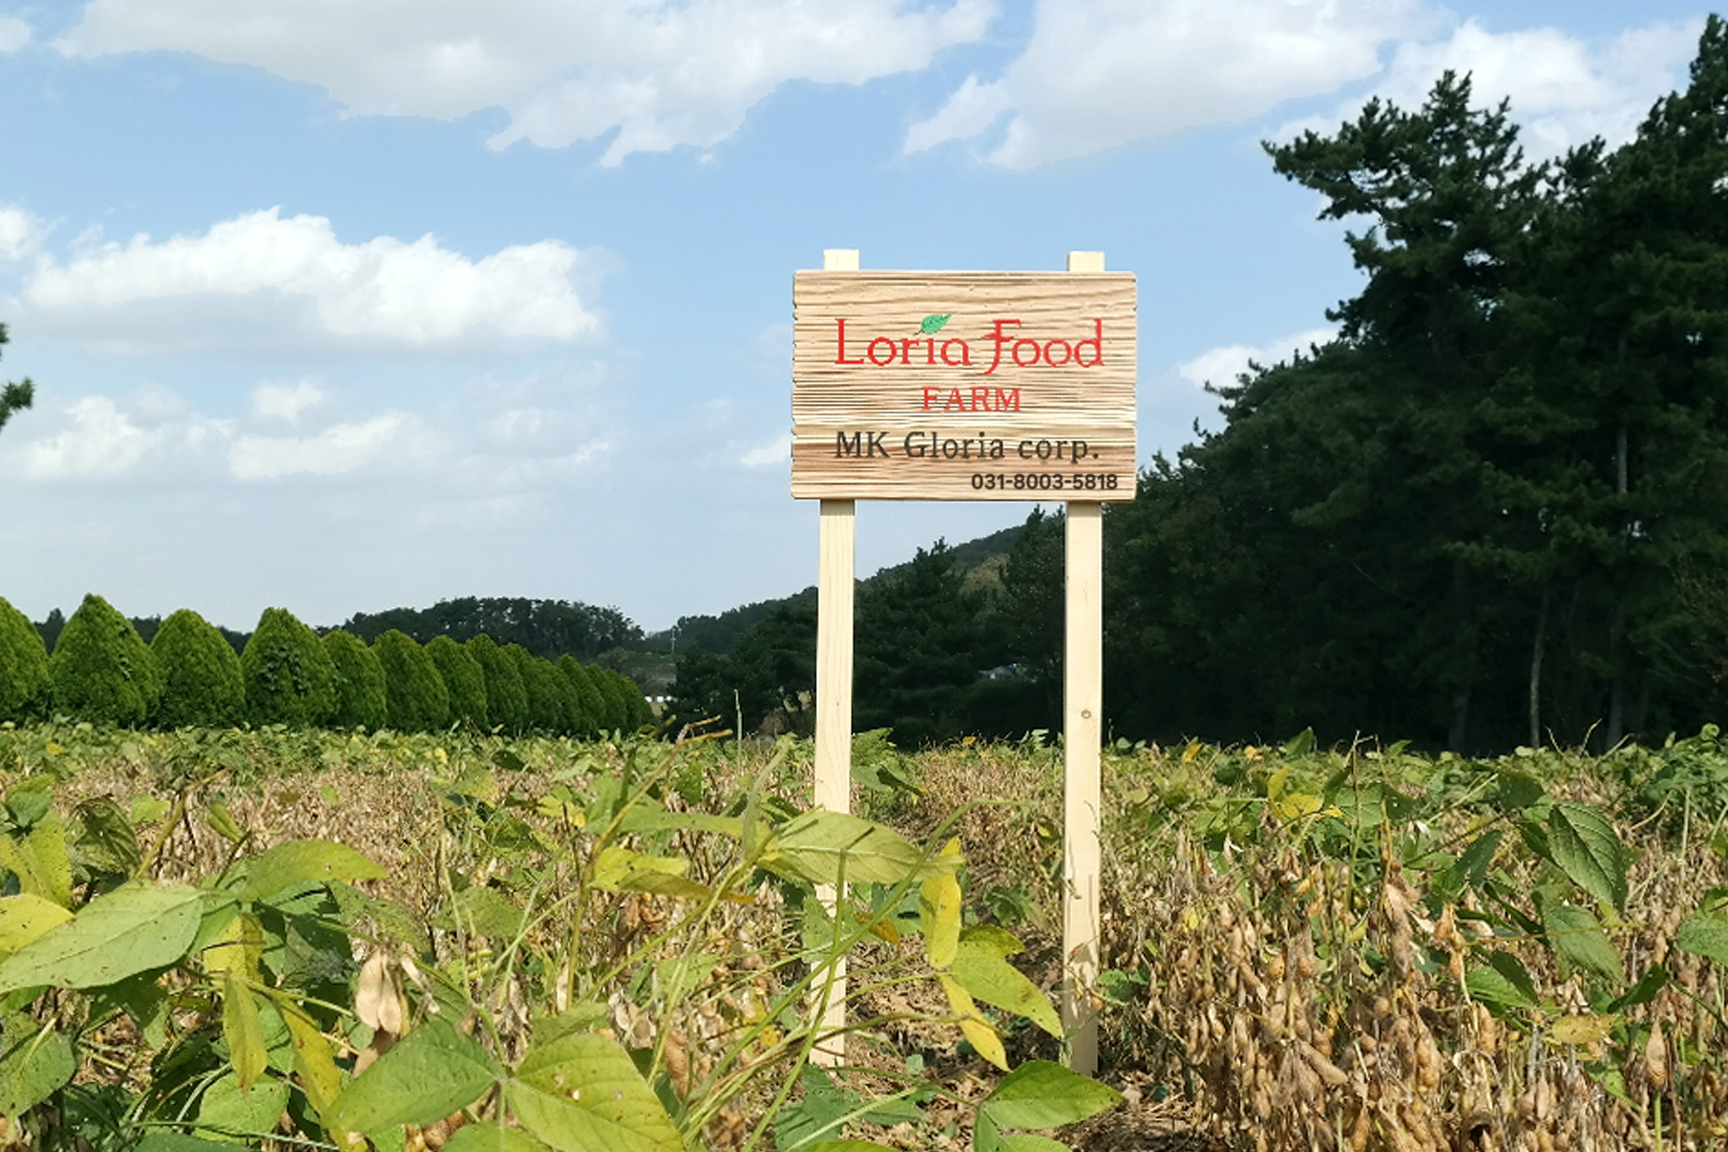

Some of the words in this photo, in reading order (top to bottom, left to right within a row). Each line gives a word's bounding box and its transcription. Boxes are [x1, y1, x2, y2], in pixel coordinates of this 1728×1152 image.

[835, 318, 972, 366] Loria
[980, 318, 1104, 375] Food
[922, 386, 1022, 412] FARM
[834, 431, 890, 458] MK
[903, 431, 1005, 459] Gloria
[1017, 438, 1099, 464] corp.
[971, 473, 1118, 490] 031-8003-5818
